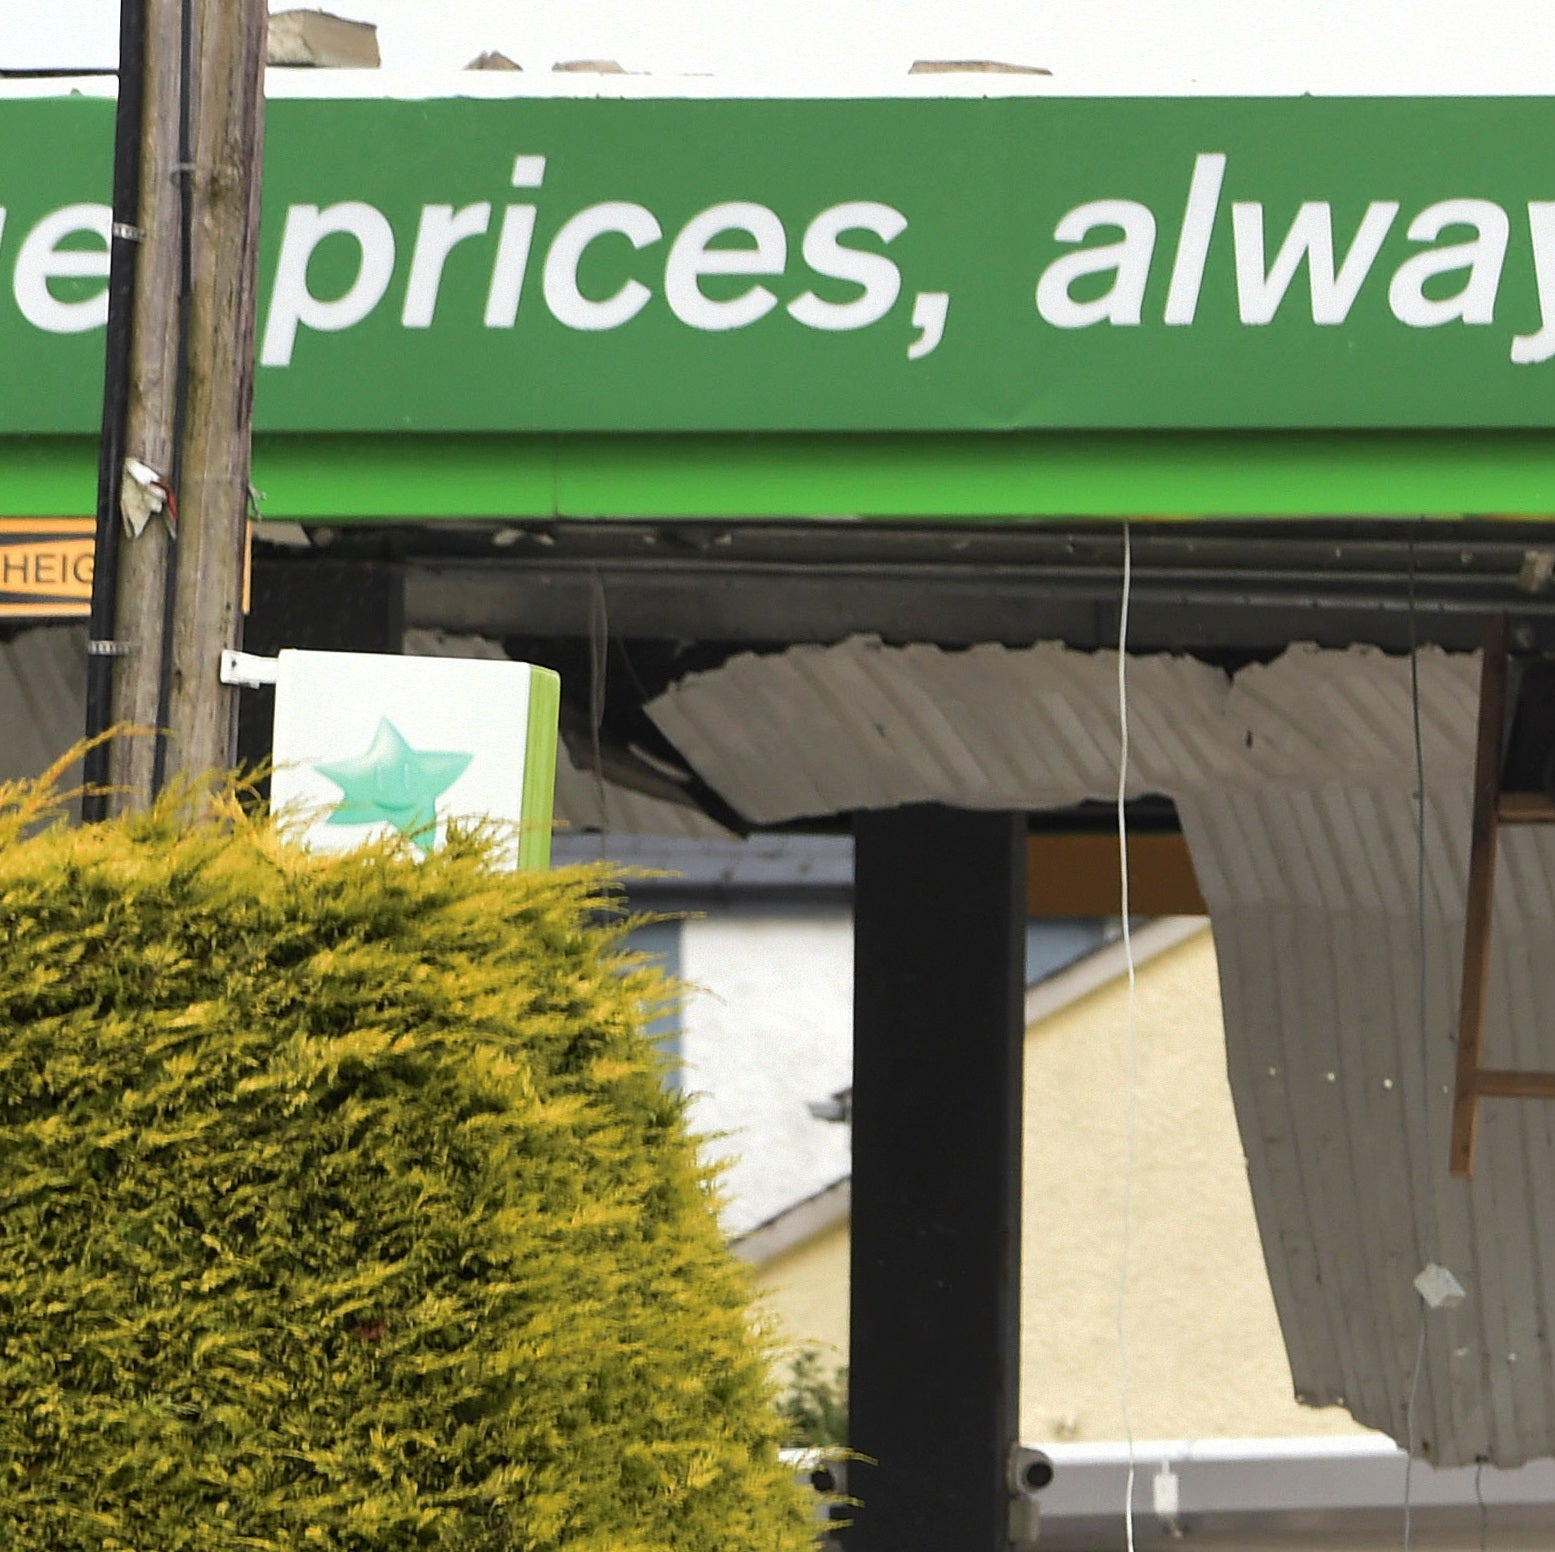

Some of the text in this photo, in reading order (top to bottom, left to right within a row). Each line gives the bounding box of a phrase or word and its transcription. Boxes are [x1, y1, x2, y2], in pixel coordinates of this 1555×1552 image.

[0, 203, 113, 333] e
[261, 155, 950, 367] prices,
[3, 552, 96, 584] HEIG
